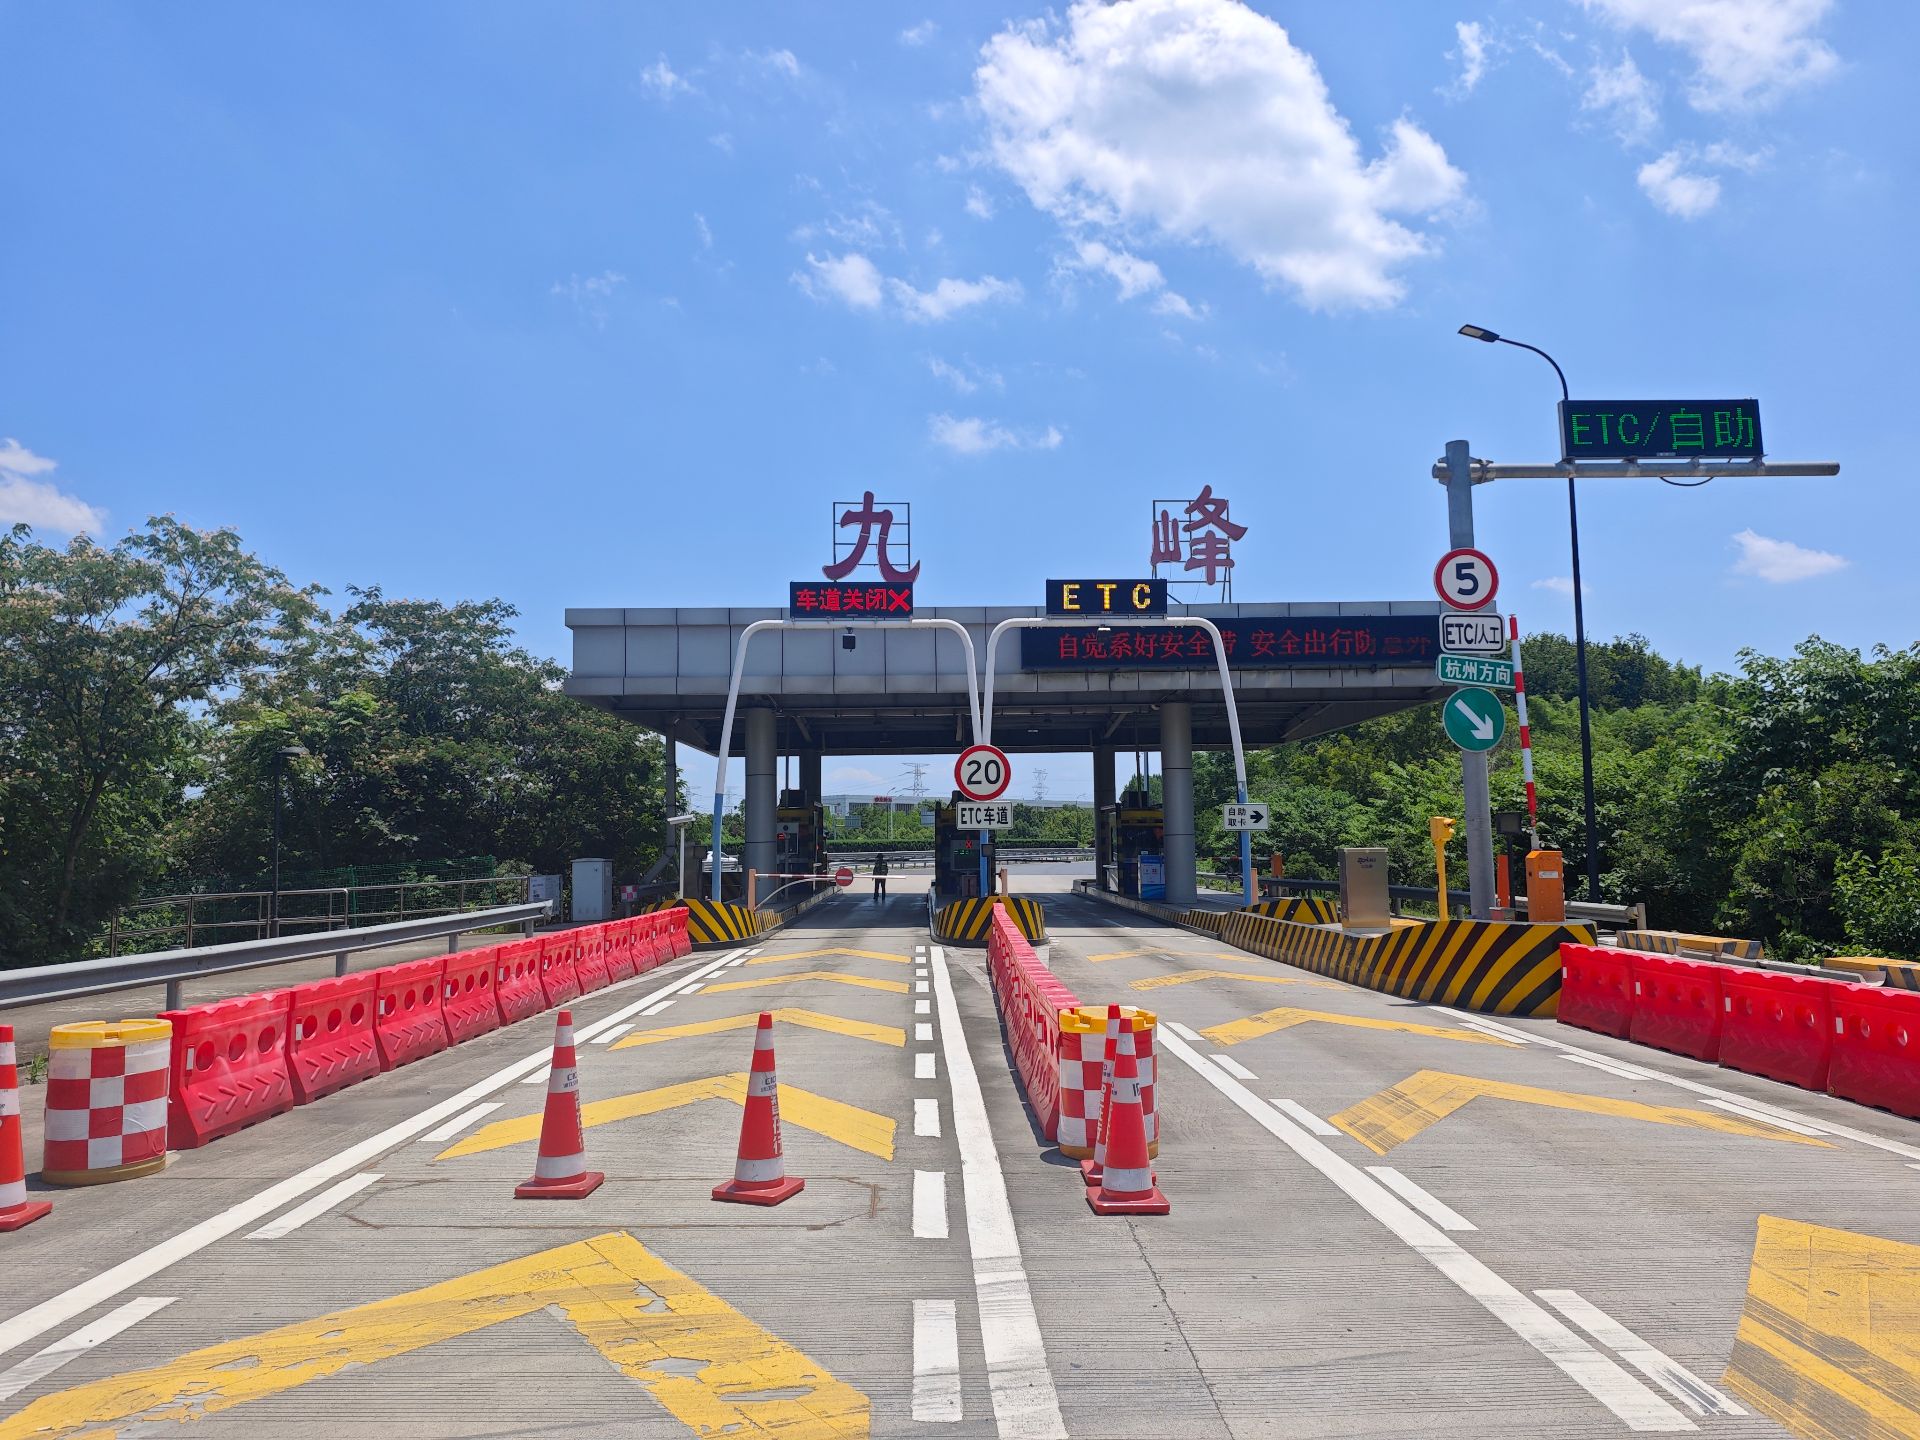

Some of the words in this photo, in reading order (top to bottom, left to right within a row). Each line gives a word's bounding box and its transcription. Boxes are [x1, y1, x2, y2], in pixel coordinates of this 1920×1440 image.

[1571, 407, 1755, 450] ETC/自助
[821, 491, 921, 583] 九
[1150, 484, 1247, 585] 峰
[1455, 562, 1479, 596] 5
[1062, 583, 1151, 610] ETC
[1445, 623, 1500, 645] ETC/人工
[1445, 659, 1511, 685] 杭州方向
[966, 759, 1001, 785] 20
[960, 806, 1009, 825] ETC车道
[1228, 807, 1247, 817] 自助
[1228, 818, 1247, 827] 取卡
